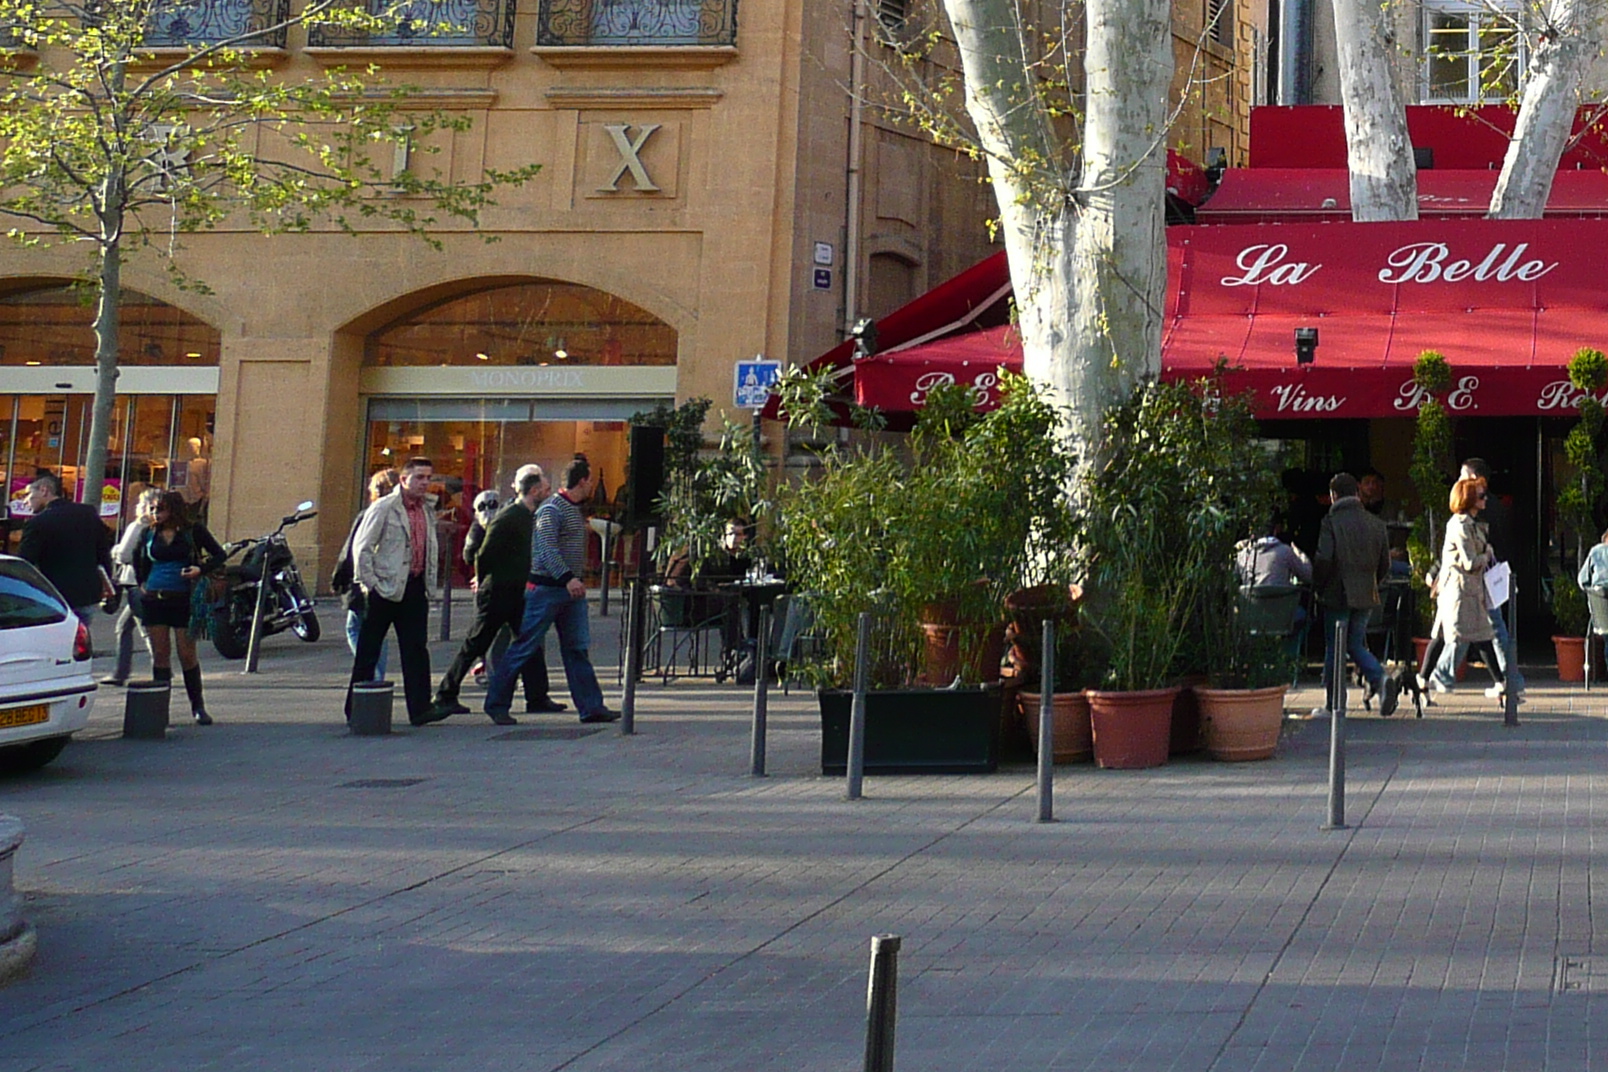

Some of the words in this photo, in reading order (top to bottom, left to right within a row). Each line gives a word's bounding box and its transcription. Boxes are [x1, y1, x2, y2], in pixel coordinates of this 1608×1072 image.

[1221, 243, 1322, 287] La
[1378, 242, 1560, 284] Belle
[470, 370, 585, 387] MONOPRIX
[1270, 384, 1347, 412] Vins
[1448, 375, 1479, 410] E.
